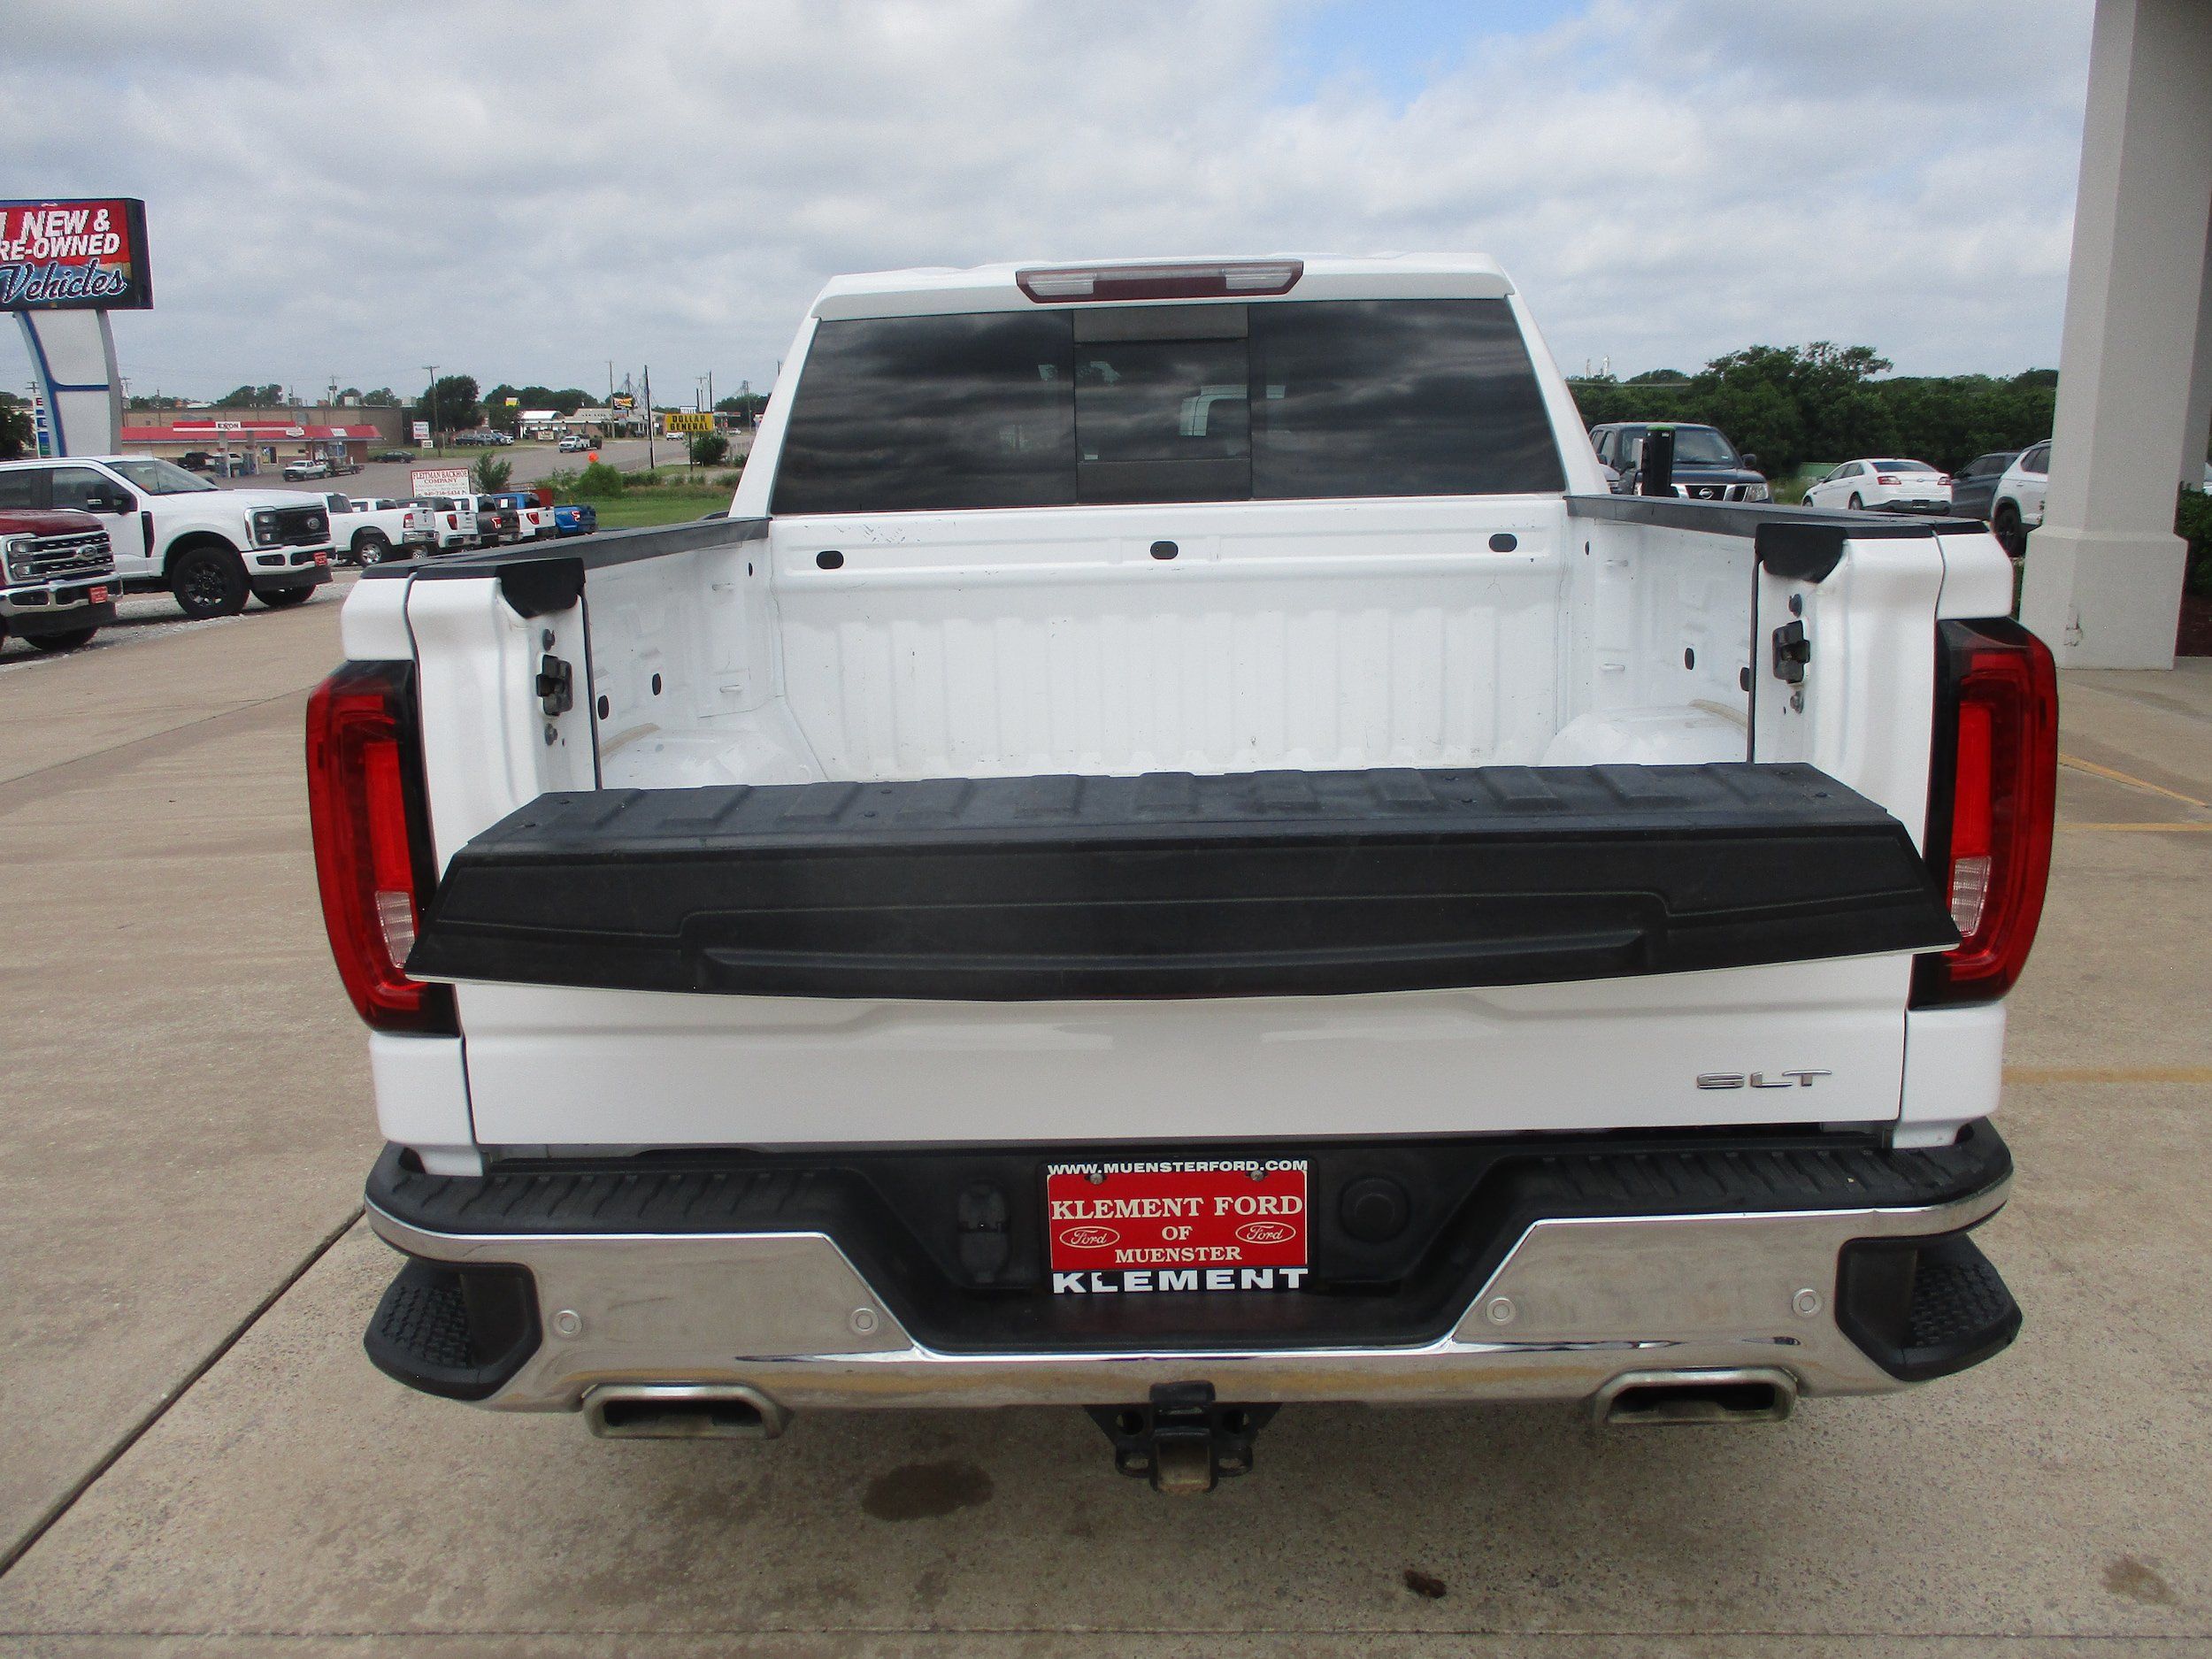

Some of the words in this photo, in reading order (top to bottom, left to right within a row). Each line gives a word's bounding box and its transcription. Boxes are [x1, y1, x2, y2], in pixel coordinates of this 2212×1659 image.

[19, 209, 89, 245] NEW
[93, 208, 111, 232] &
[0, 257, 127, 303] Vehicles
[1696, 1069, 1832, 1089] SLT
[1048, 1160, 1308, 1174] WWW.MUENSTERFORD.COM
[1051, 1198, 1203, 1220] KLEMENT
[1213, 1195, 1303, 1217] FORD
[1070, 1229, 1107, 1245] Ford
[1162, 1225, 1194, 1240] OF
[1246, 1225, 1283, 1240] Ford
[1115, 1246, 1242, 1263] MUENSTER
[1052, 1268, 1309, 1294] KLEMENT
